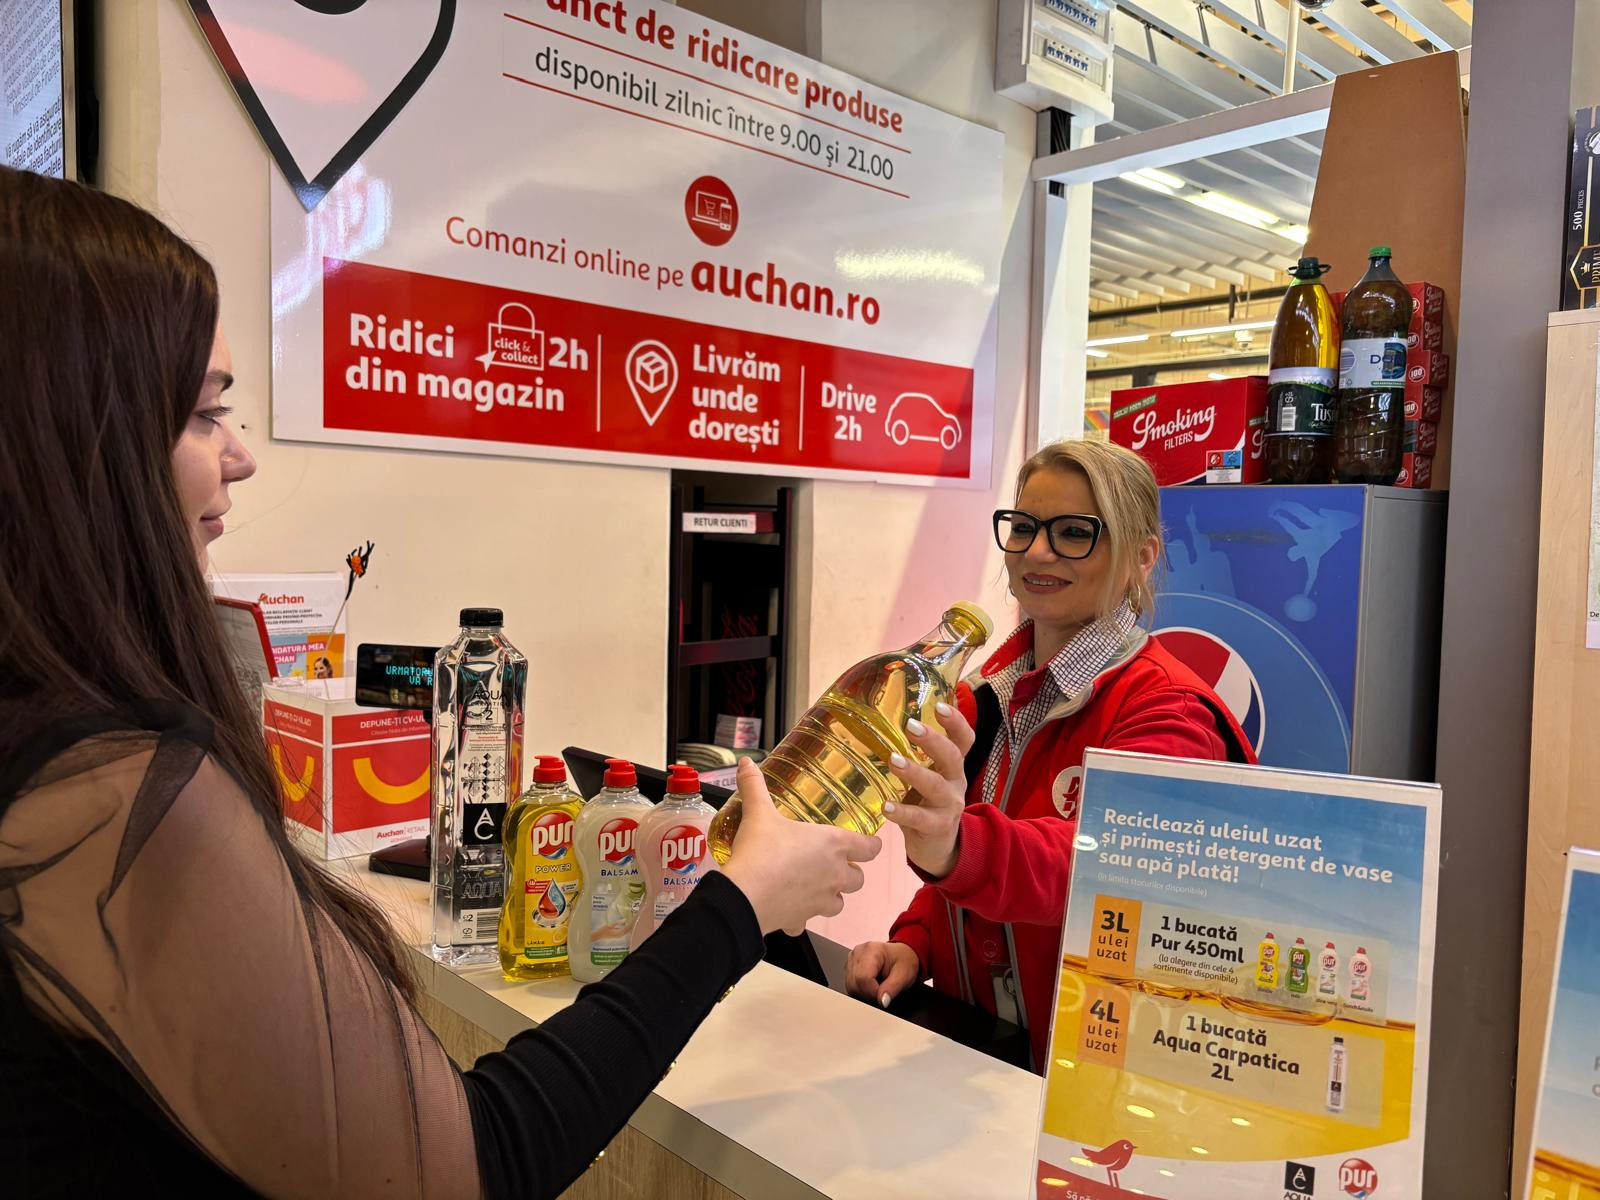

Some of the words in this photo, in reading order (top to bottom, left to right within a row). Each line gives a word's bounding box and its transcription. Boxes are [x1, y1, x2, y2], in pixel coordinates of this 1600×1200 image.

[547, 0, 626, 34] unct
[635, 9, 675, 50] de
[688, 28, 799, 95] ridicare
[804, 77, 903, 133] produse
[535, 46, 657, 107] disponibil
[664, 90, 722, 126] zilnic
[727, 106, 775, 142] între
[780, 124, 821, 156] 9.00
[847, 146, 894, 180] 21.00
[33, 116, 61, 154] identificare
[1573, 211, 1583, 230] 500
[446, 216, 566, 265] Comanzi
[574, 248, 650, 281] online
[657, 266, 684, 291] pe
[691, 260, 881, 326] auchan.ro
[349, 312, 455, 359] Ridici
[494, 337, 521, 351] click
[501, 351, 538, 365] collect
[548, 336, 590, 372] 2h
[692, 344, 781, 383] Livrăm
[345, 356, 407, 394] din
[417, 376, 565, 413] magazin
[1410, 368, 1423, 377] 100
[692, 384, 759, 414] unde
[821, 381, 877, 414] Drive
[688, 412, 780, 453] dorești
[834, 414, 863, 442] 2h
[1132, 405, 1216, 450] Smoking
[1164, 431, 1193, 451] FILTERS
[694, 517, 719, 527] RETUR
[259, 593, 304, 604] Auchan
[409, 675, 421, 685] VA
[486, 710, 493, 720] 2
[376, 829, 404, 839] Auchan
[533, 820, 576, 856] pur
[1104, 808, 1205, 836] Reciclează
[1210, 820, 1269, 846] uleiul
[1274, 834, 1322, 852] uzat
[662, 834, 705, 869] pur
[1101, 828, 1117, 848] și
[1120, 832, 1201, 858] primești
[1205, 842, 1306, 870] detergent
[1310, 856, 1337, 875] de
[1342, 864, 1393, 883] vase
[535, 863, 572, 874] POWER
[601, 869, 640, 877] BALSAM
[1099, 849, 1132, 867] sau
[1136, 855, 1173, 876] apă
[1177, 860, 1240, 883] plată!
[664, 877, 702, 886] BALSAM
[1108, 873, 1129, 885] limita
[1100, 910, 1130, 934] 3L
[1161, 916, 1171, 931] 1
[1175, 917, 1238, 942] bucată
[1098, 934, 1129, 949] ulei
[1151, 933, 1181, 952] Pur
[1184, 939, 1245, 964] 450ml
[1096, 948, 1128, 962] uzat
[1170, 957, 1197, 970] alegere
[1198, 961, 1211, 971] din
[1212, 964, 1227, 973] cele
[1153, 962, 1193, 977] sortimente
[1194, 968, 1239, 985] disponibile)
[1089, 998, 1120, 1024] 4L
[1087, 1023, 1120, 1039] ulei
[1186, 1015, 1196, 1031] 1
[1201, 1017, 1268, 1047] bucată
[1086, 1037, 1118, 1054] uzat
[1152, 1029, 1201, 1054] Aqua
[1205, 1041, 1301, 1075] Carpatica
[1210, 1062, 1235, 1082] 2L
[1340, 1167, 1376, 1191] pur
